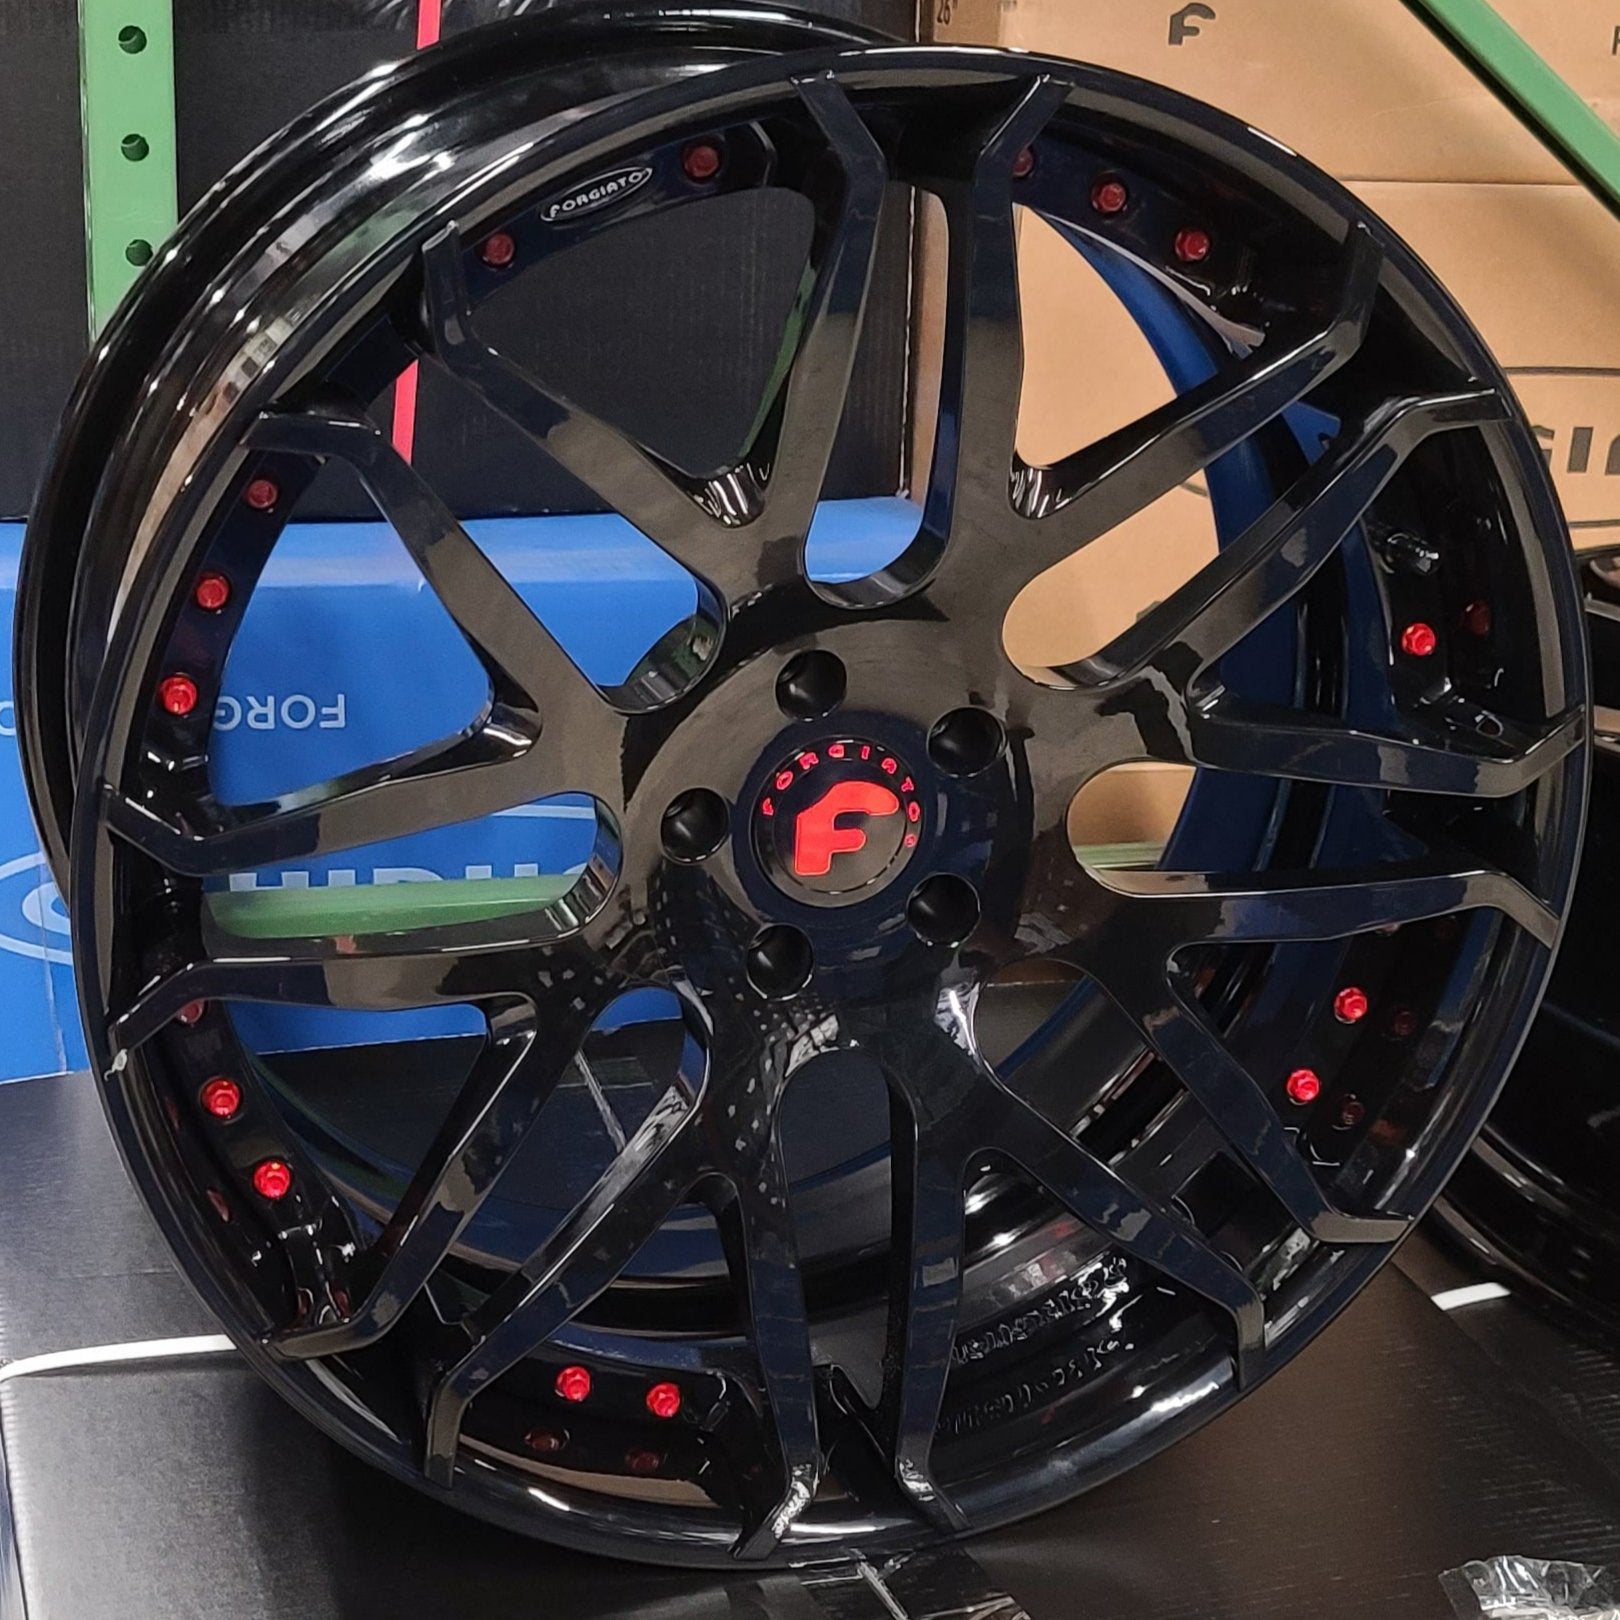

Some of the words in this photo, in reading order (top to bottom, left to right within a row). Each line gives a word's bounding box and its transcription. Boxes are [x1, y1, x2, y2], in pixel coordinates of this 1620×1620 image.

[1168, 2, 1217, 46] F
[549, 171, 643, 218] FORGIATO
[762, 744, 921, 822] FORGIATO
[795, 780, 900, 876] F
